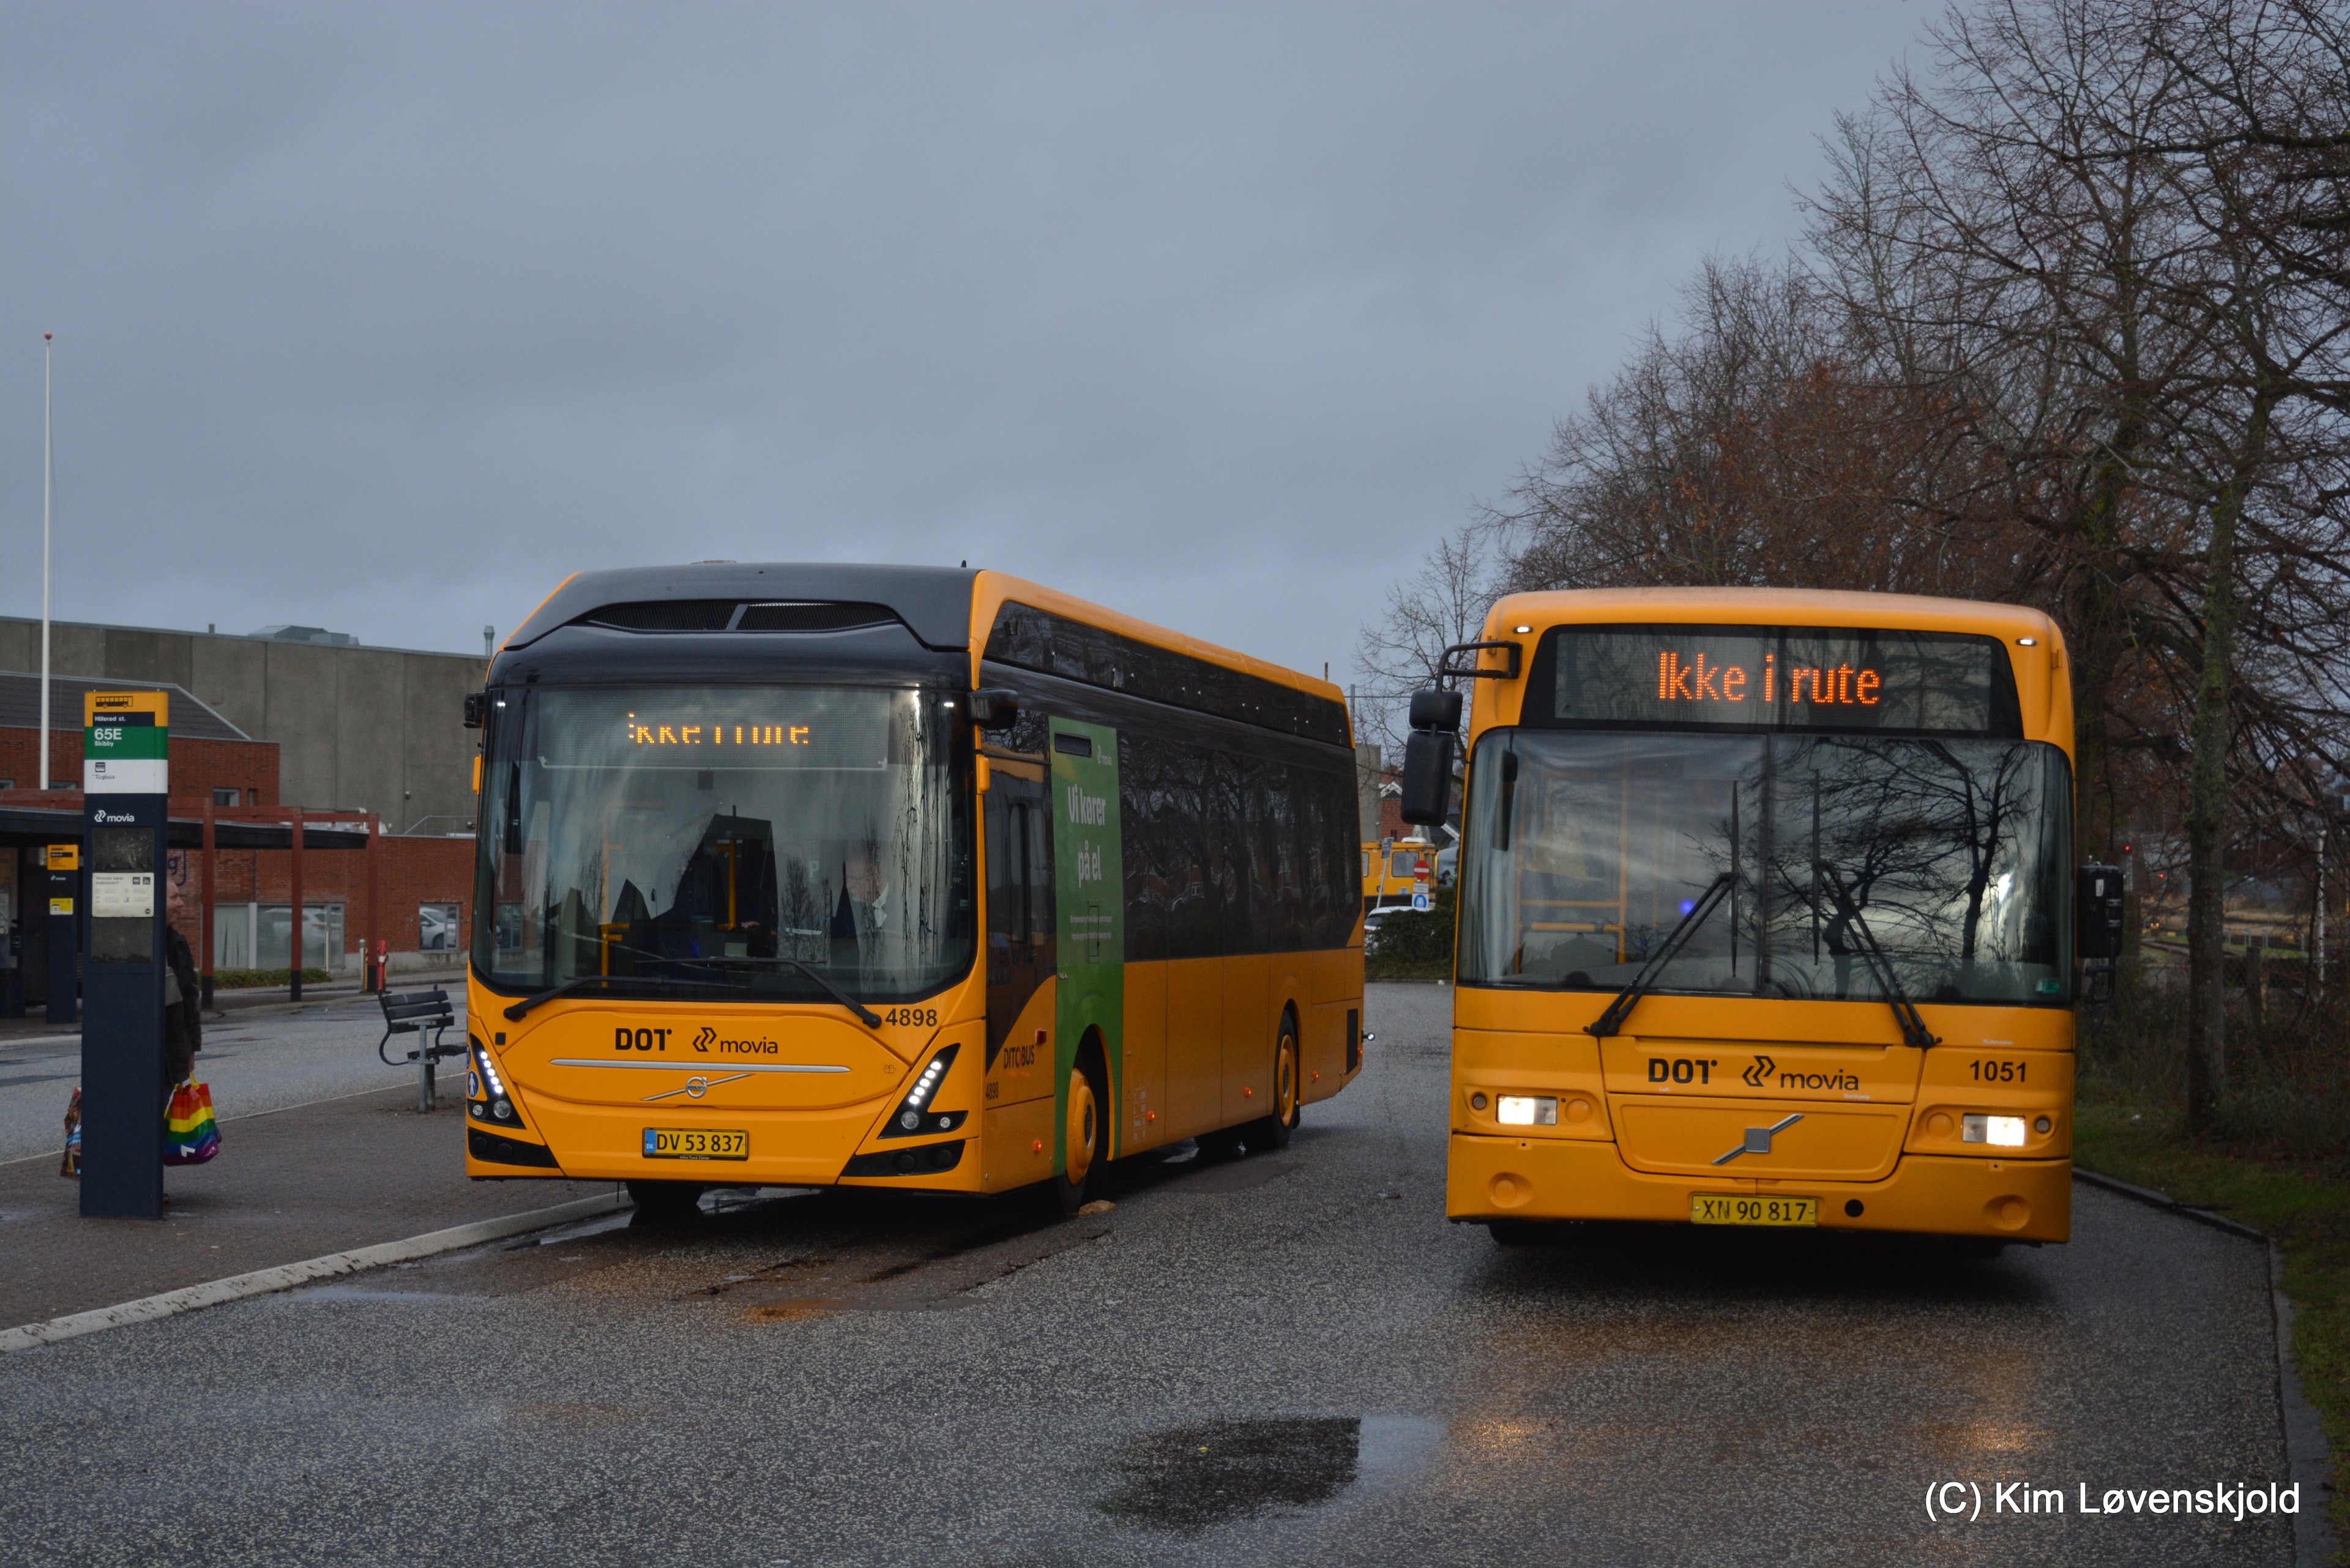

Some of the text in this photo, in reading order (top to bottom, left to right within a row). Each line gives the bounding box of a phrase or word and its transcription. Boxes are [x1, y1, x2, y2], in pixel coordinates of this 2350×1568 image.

[1659, 652, 1880, 704] Ikke i rute
[94, 728, 122, 740] 65E
[1067, 783, 1106, 826] Vi kører
[106, 813, 135, 823] movia
[1078, 840, 1102, 887] på el
[885, 1008, 938, 1027] 4898
[615, 1028, 779, 1054] DOT movia
[1003, 1044, 1035, 1069] DITOBUS
[1648, 1058, 1859, 1091] DOT movia
[1969, 1059, 2026, 1083] 1051
[985, 1081, 999, 1100] 4898
[656, 1133, 744, 1152] DV 53 837
[1703, 1200, 1808, 1222] XN 90 817
